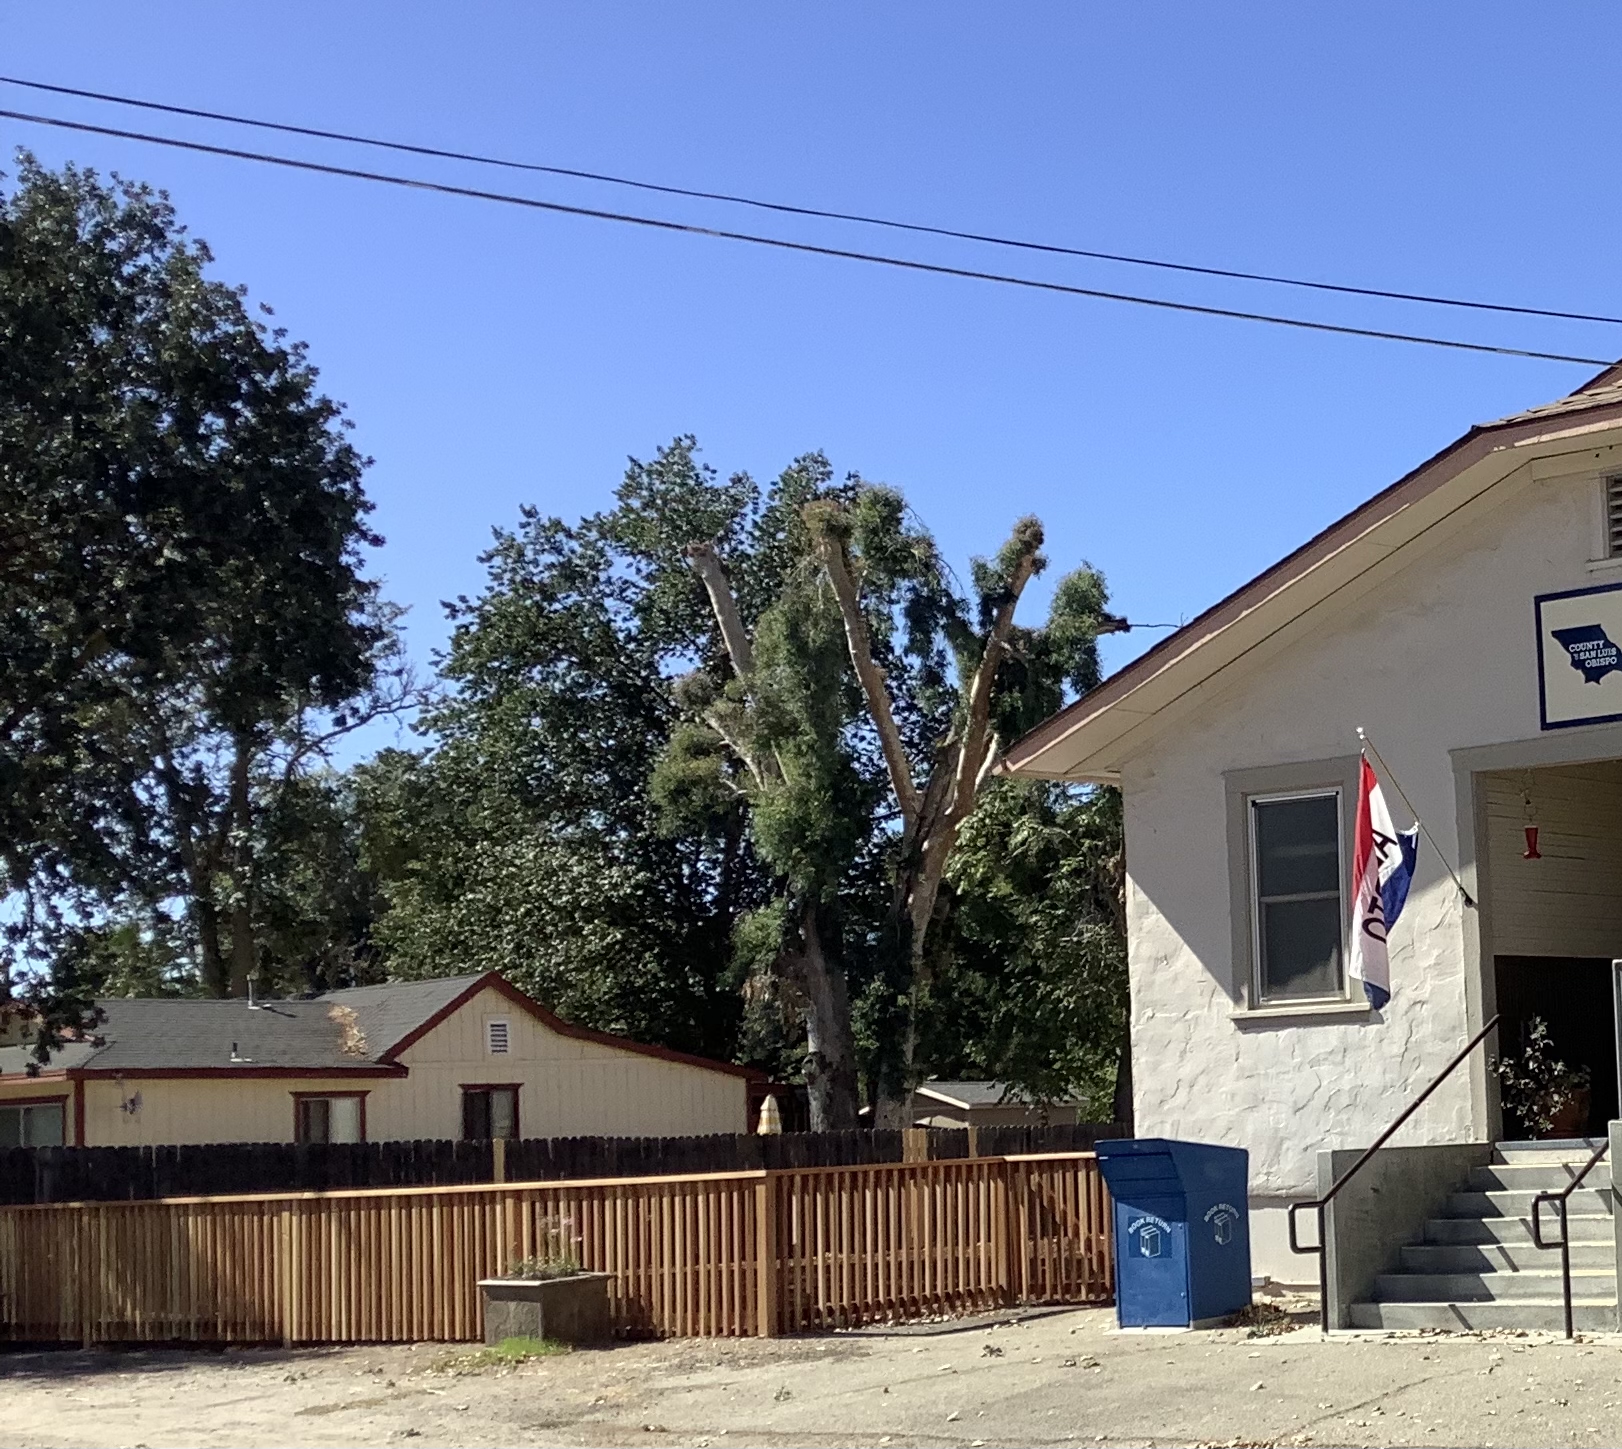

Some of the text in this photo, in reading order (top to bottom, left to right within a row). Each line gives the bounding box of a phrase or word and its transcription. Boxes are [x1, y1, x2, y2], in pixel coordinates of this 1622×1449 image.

[1569, 640, 1605, 652] COUNTY
[1580, 650, 1597, 660] SAN
[1598, 647, 1617, 657] LUIS
[1585, 656, 1617, 668] OBISPO
[1128, 1216, 1171, 1234] BOOK RETURN
